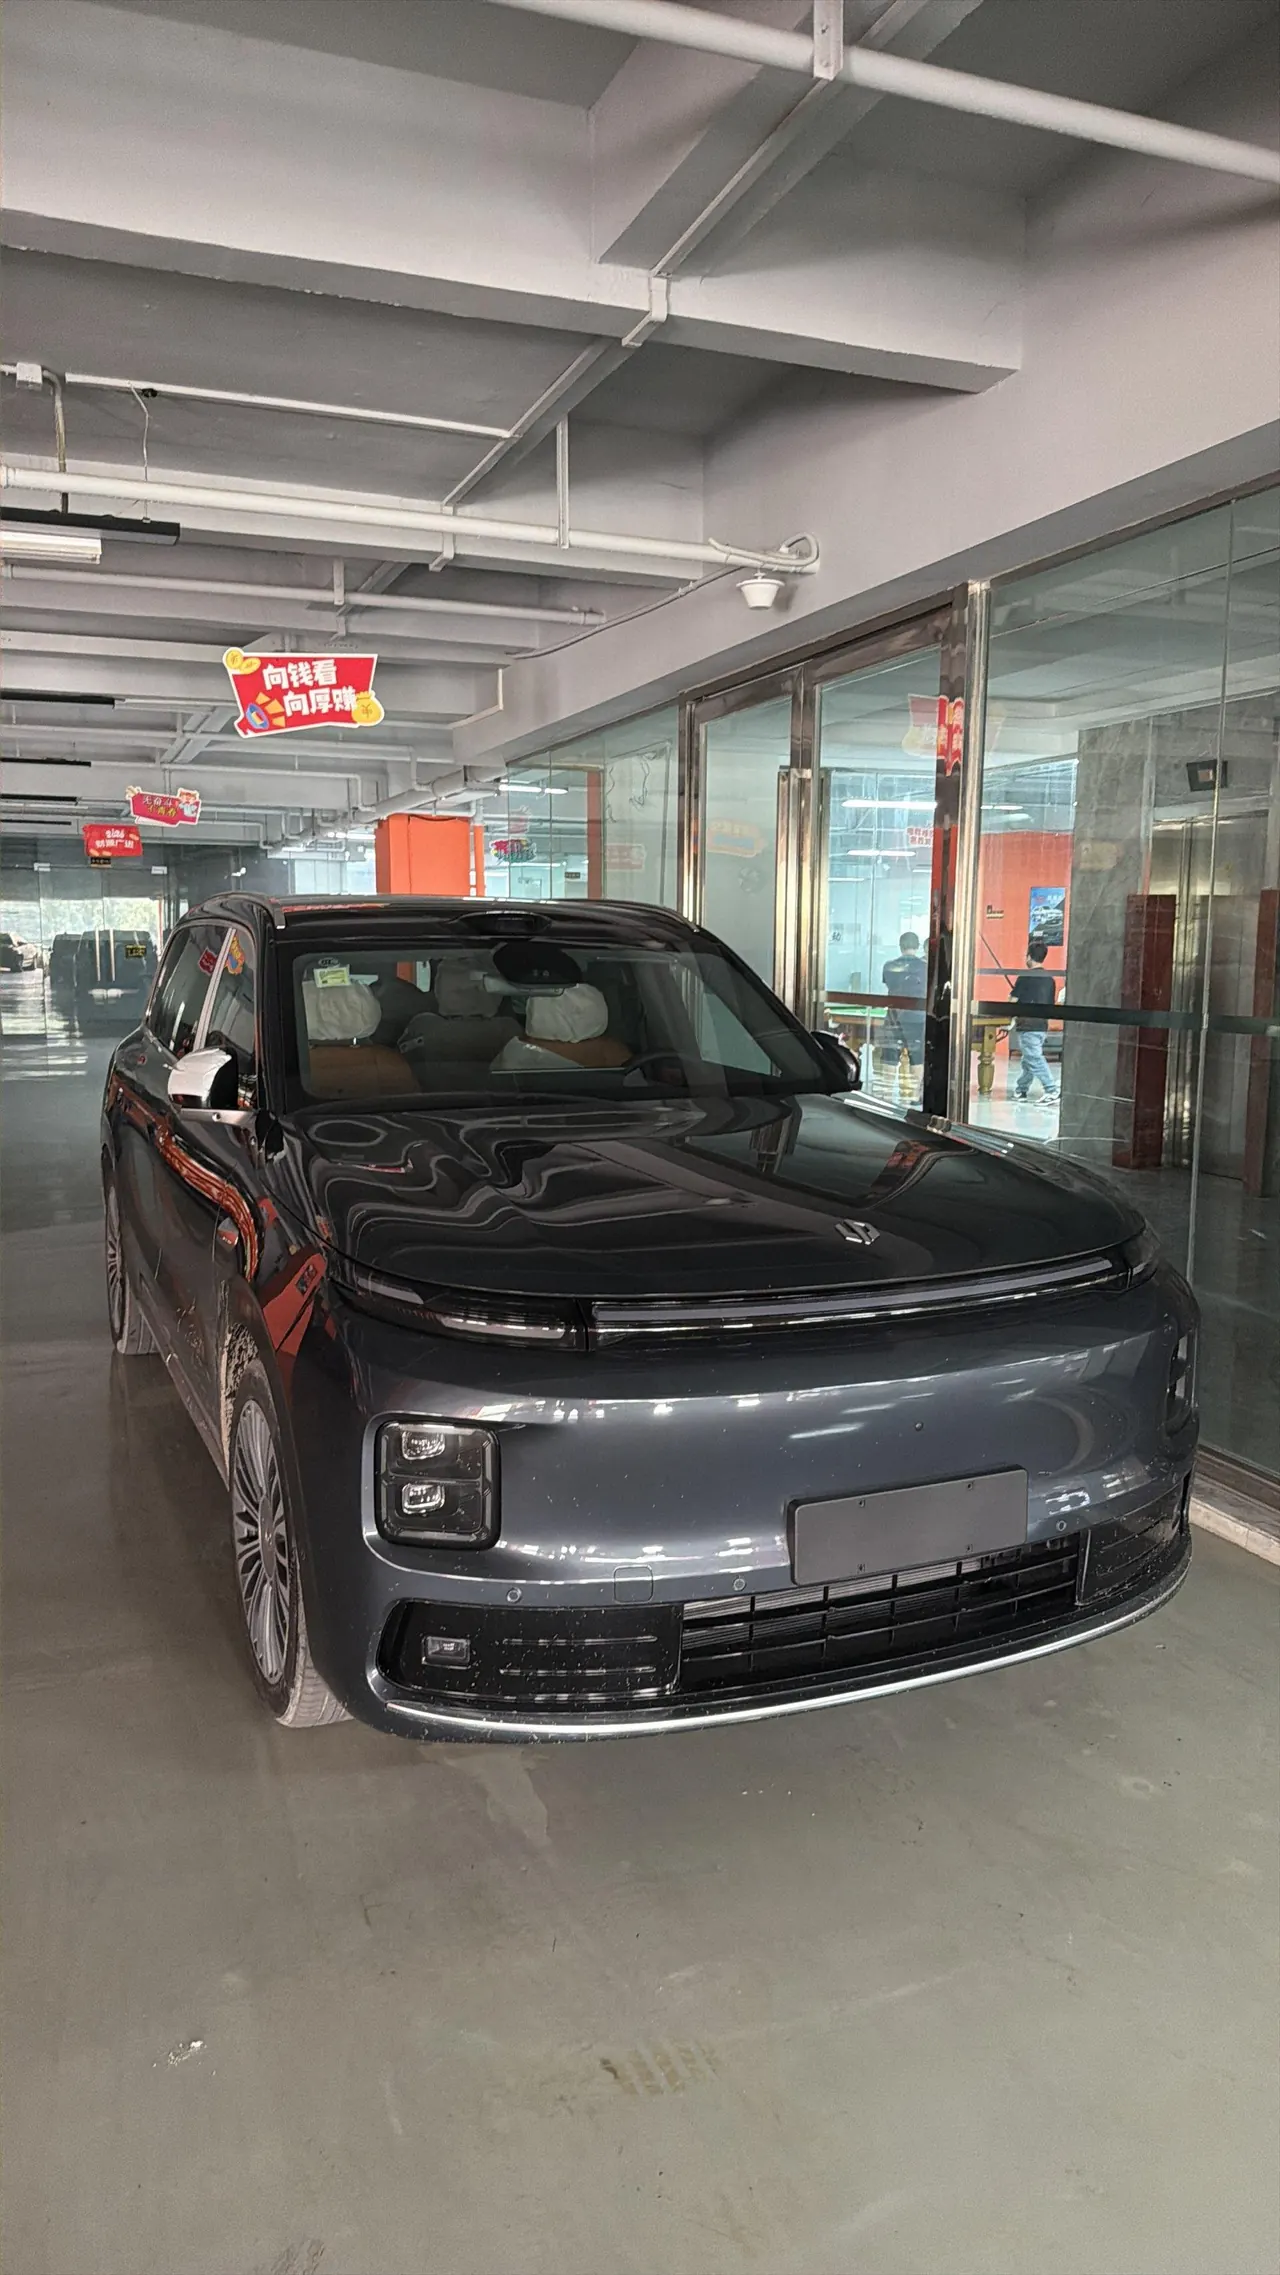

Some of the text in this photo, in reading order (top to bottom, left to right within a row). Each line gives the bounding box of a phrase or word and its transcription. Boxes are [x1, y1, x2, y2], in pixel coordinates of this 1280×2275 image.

[262, 658, 338, 691] 向钱看
[282, 685, 357, 717] 向厚赚
